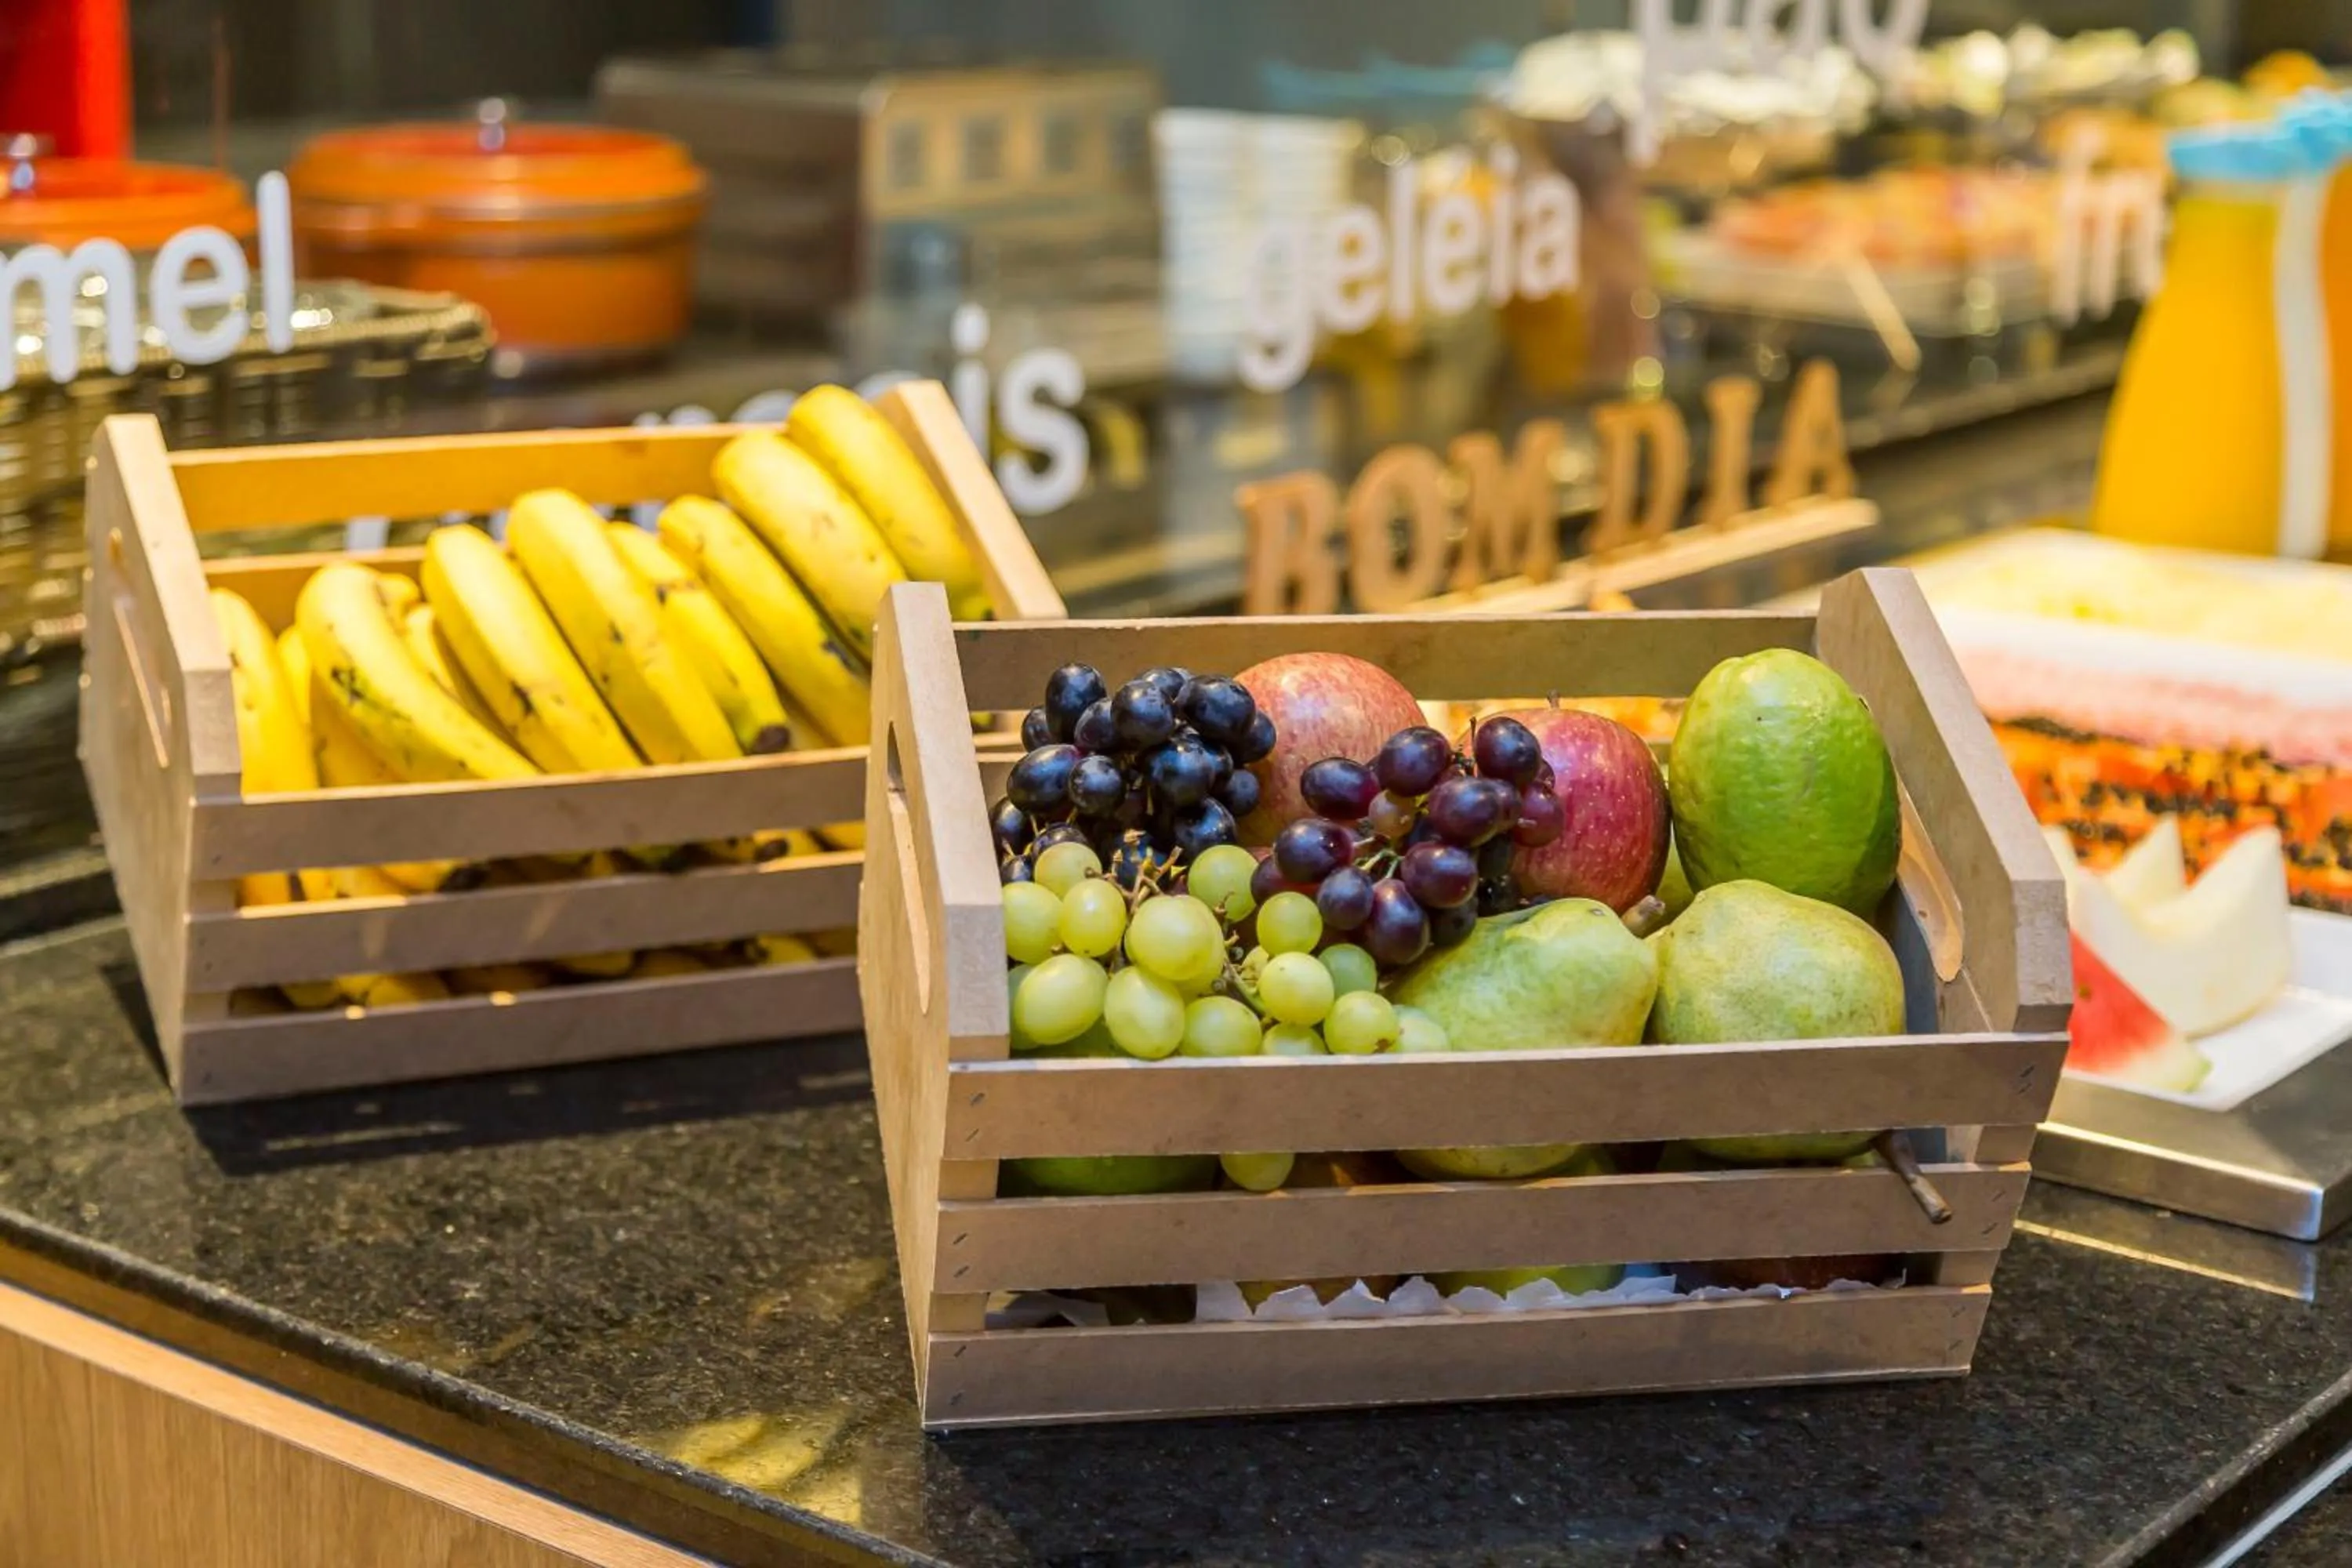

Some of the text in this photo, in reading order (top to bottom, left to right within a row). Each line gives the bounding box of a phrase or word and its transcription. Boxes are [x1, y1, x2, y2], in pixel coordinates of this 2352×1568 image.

[0, 170, 295, 391] mel
[1237, 143, 1582, 392] geleia
[1236, 416, 1566, 615] BOM
[1584, 355, 1858, 566] DIA
